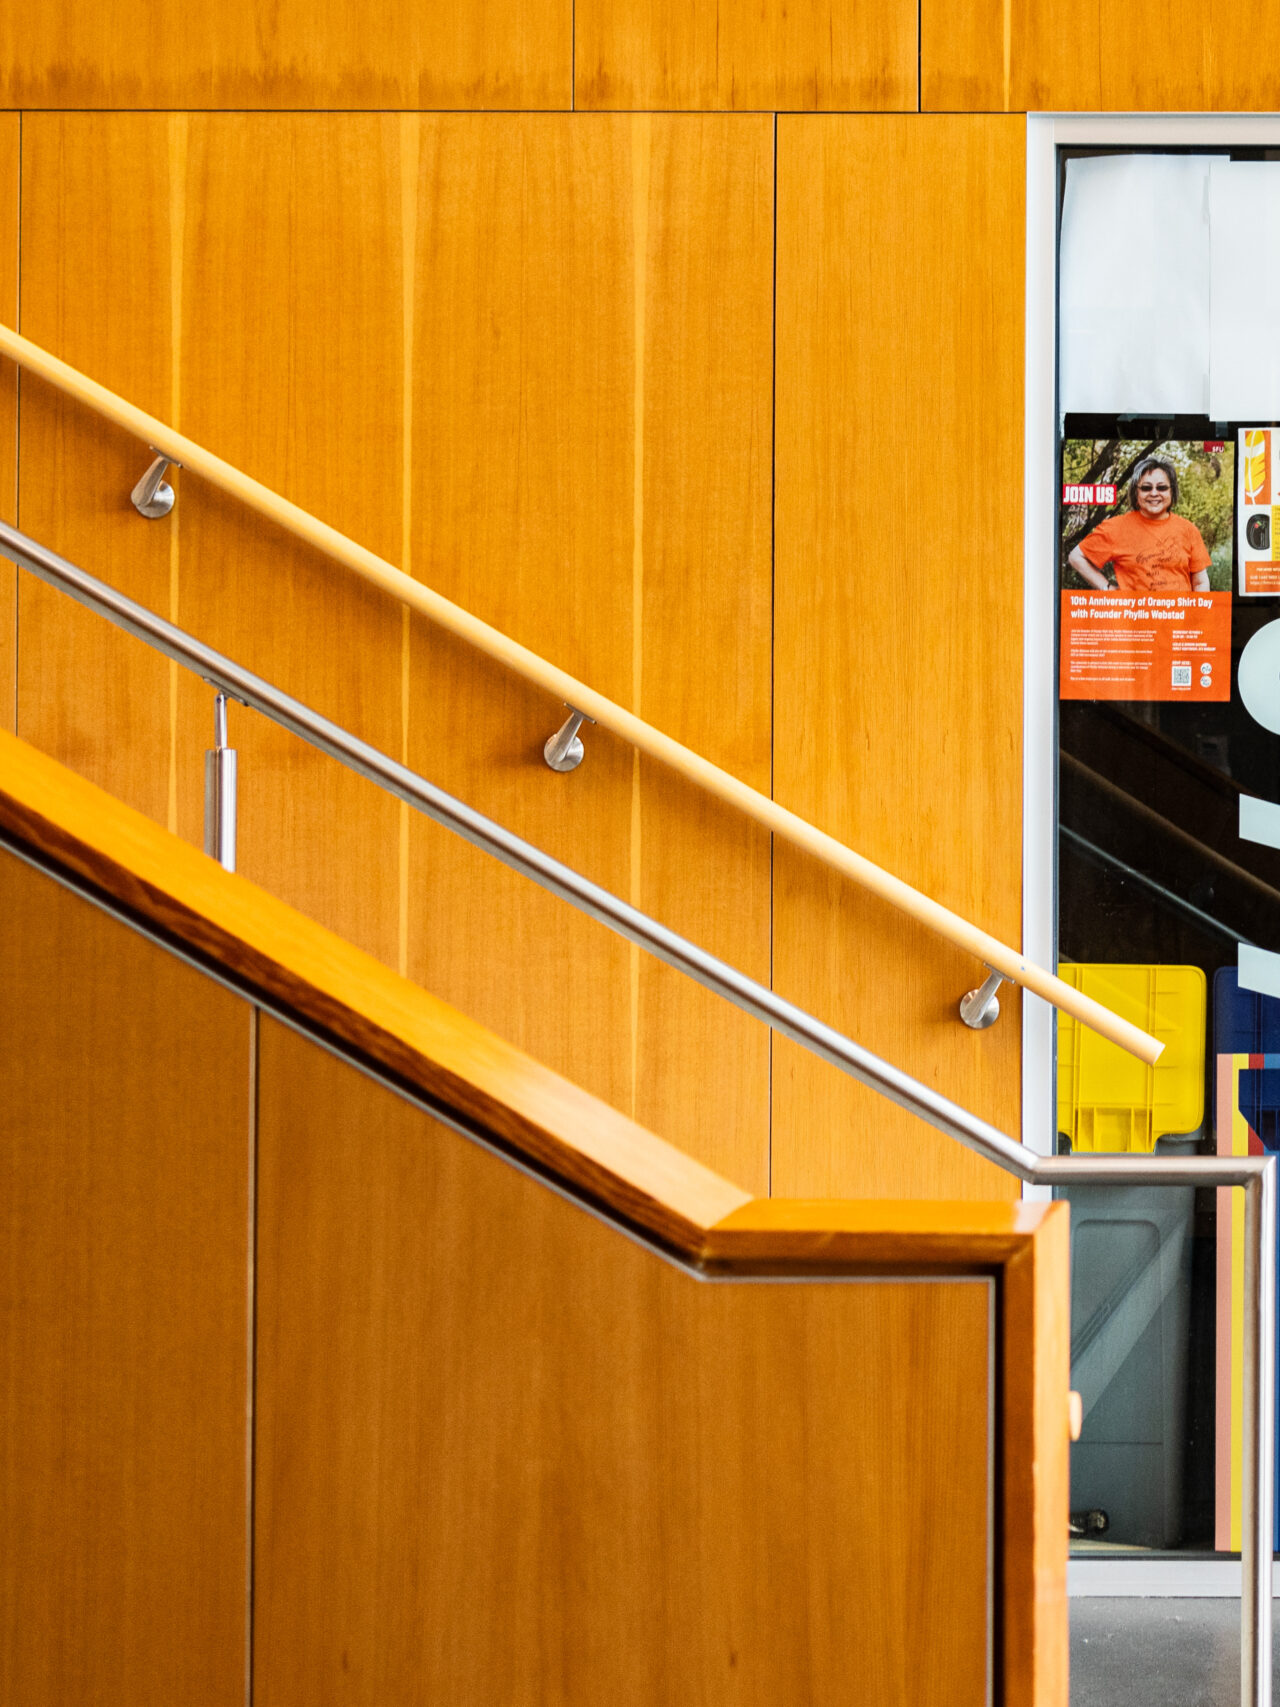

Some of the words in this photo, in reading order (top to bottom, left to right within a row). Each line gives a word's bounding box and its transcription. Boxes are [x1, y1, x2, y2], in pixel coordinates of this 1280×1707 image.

[1063, 486, 1093, 503] JOIN
[1097, 486, 1114, 504] US
[1071, 596, 1086, 606] 10th
[1089, 597, 1135, 607] Anniversary
[1138, 597, 1146, 606] of
[1148, 598, 1175, 608] Orange
[1177, 598, 1196, 607] Shirt
[1198, 598, 1213, 609] Day
[1071, 609, 1088, 618] with
[1090, 609, 1121, 619] Founder
[1124, 610, 1149, 621] Phyllis
[1151, 610, 1184, 620] Webstad
